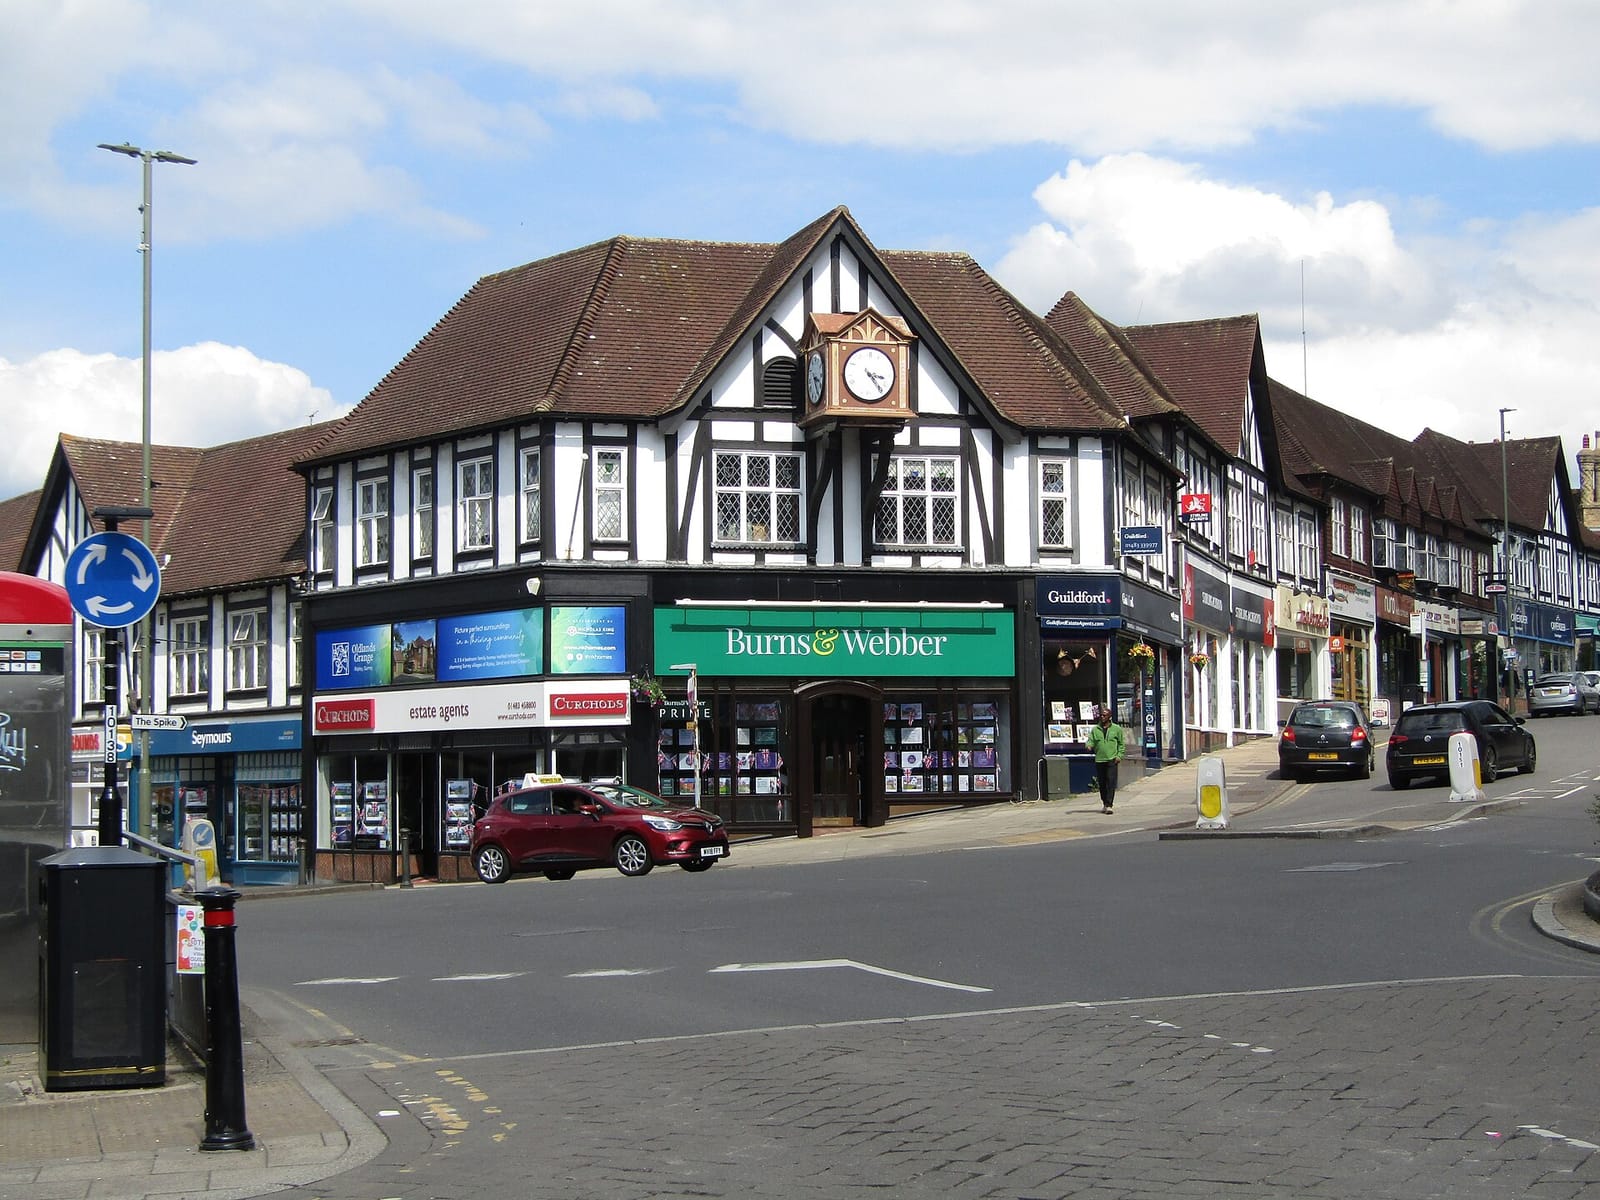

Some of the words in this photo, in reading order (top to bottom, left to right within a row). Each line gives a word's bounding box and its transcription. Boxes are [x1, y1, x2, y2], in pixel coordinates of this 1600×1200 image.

[469, 625, 484, 635] perfect
[470, 634, 493, 650] thriving
[494, 628, 525, 647] community
[725, 628, 811, 656] Burns
[812, 628, 839, 656] &
[841, 628, 948, 656] Webber
[352, 643, 376, 654] Oldlands
[354, 653, 374, 664] Grange
[554, 696, 624, 710] CURCHODS
[318, 706, 369, 724] CURCHODS
[410, 704, 436, 719] estate
[439, 703, 470, 722] agents
[136, 718, 151, 726] The
[154, 718, 178, 728] Spike
[192, 730, 232, 748] Seymours
